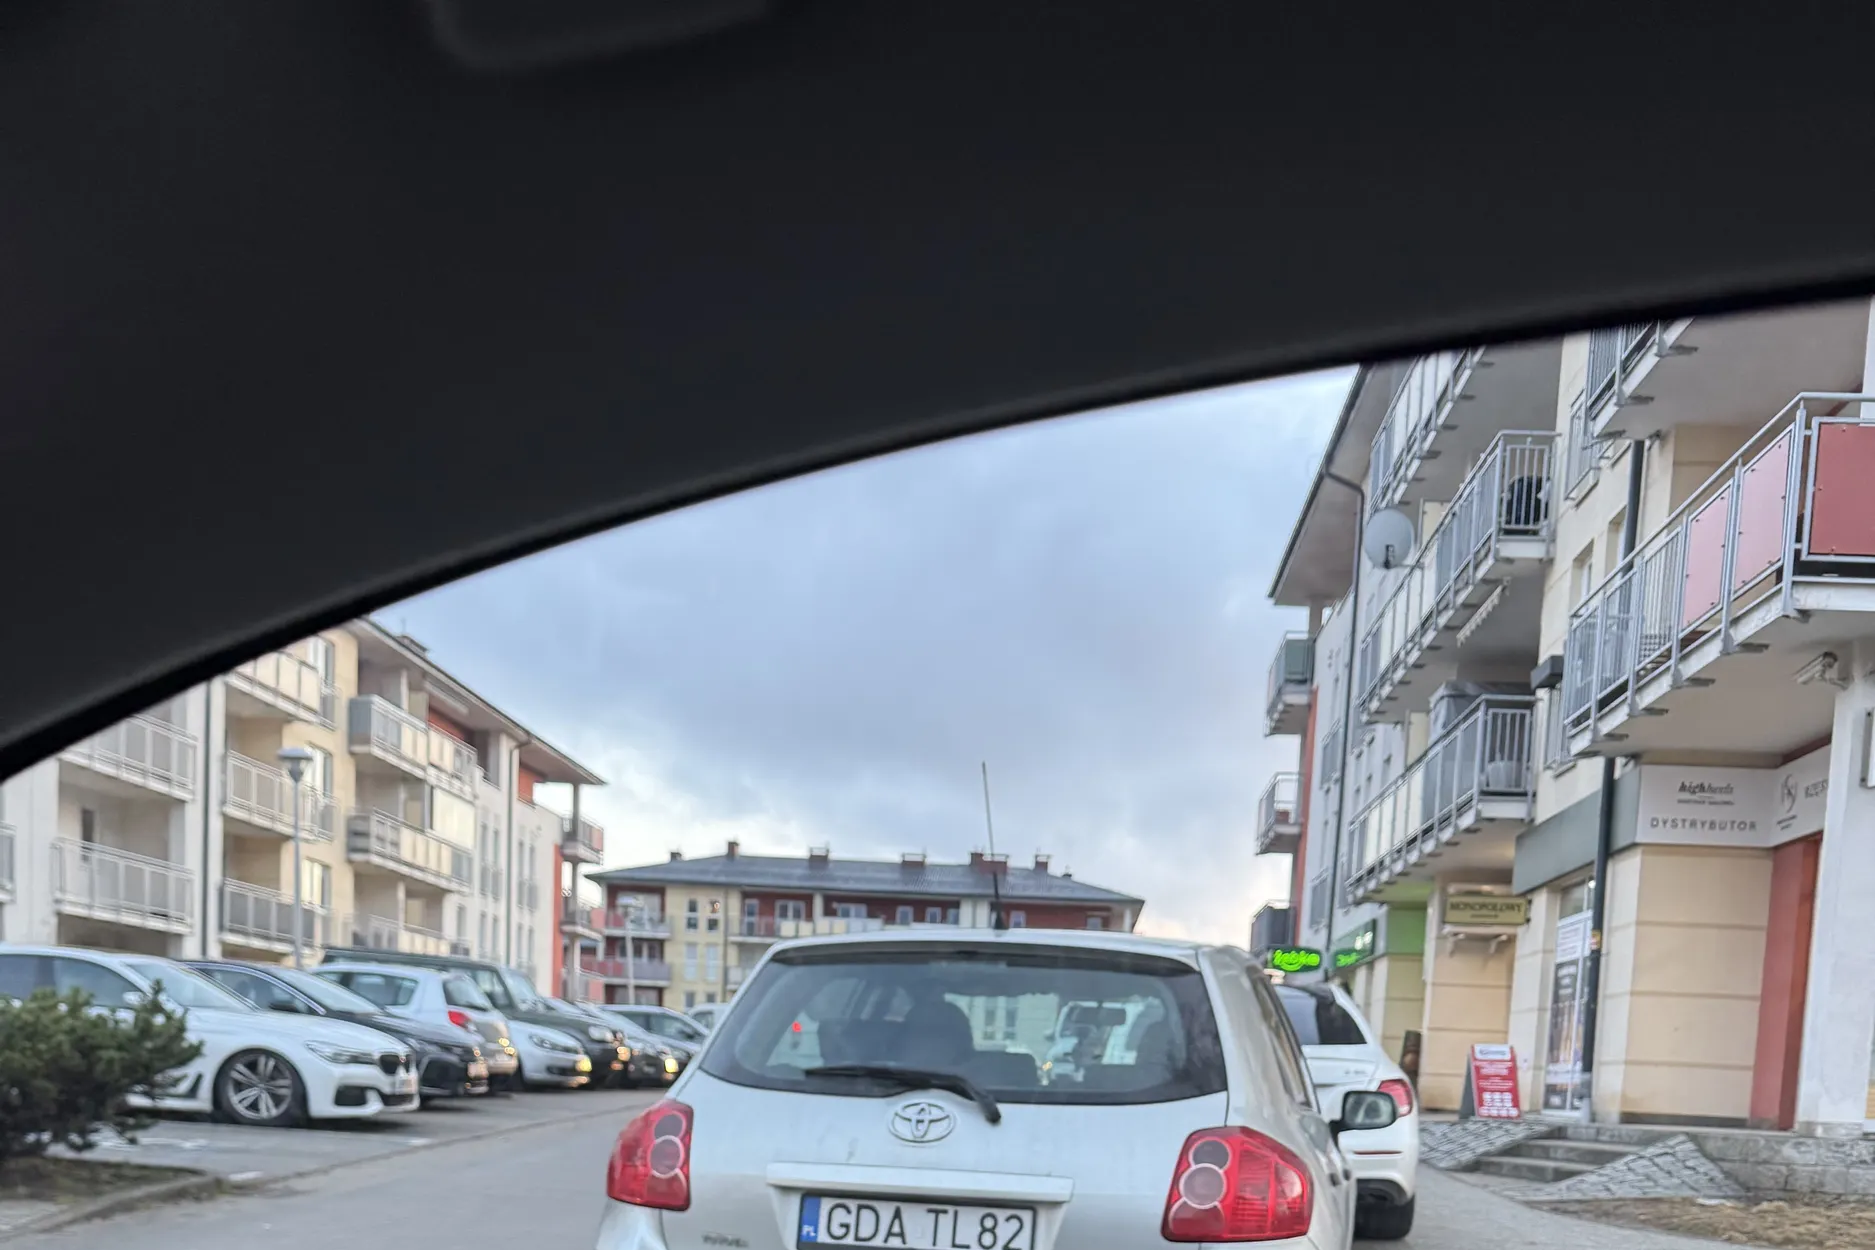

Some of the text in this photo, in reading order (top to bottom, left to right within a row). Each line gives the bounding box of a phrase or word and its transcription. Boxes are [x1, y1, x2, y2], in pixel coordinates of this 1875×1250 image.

[1650, 817, 1757, 831] DYSTRYBUTOR
[802, 1225, 816, 1236] PL
[827, 1203, 907, 1245] GDA
